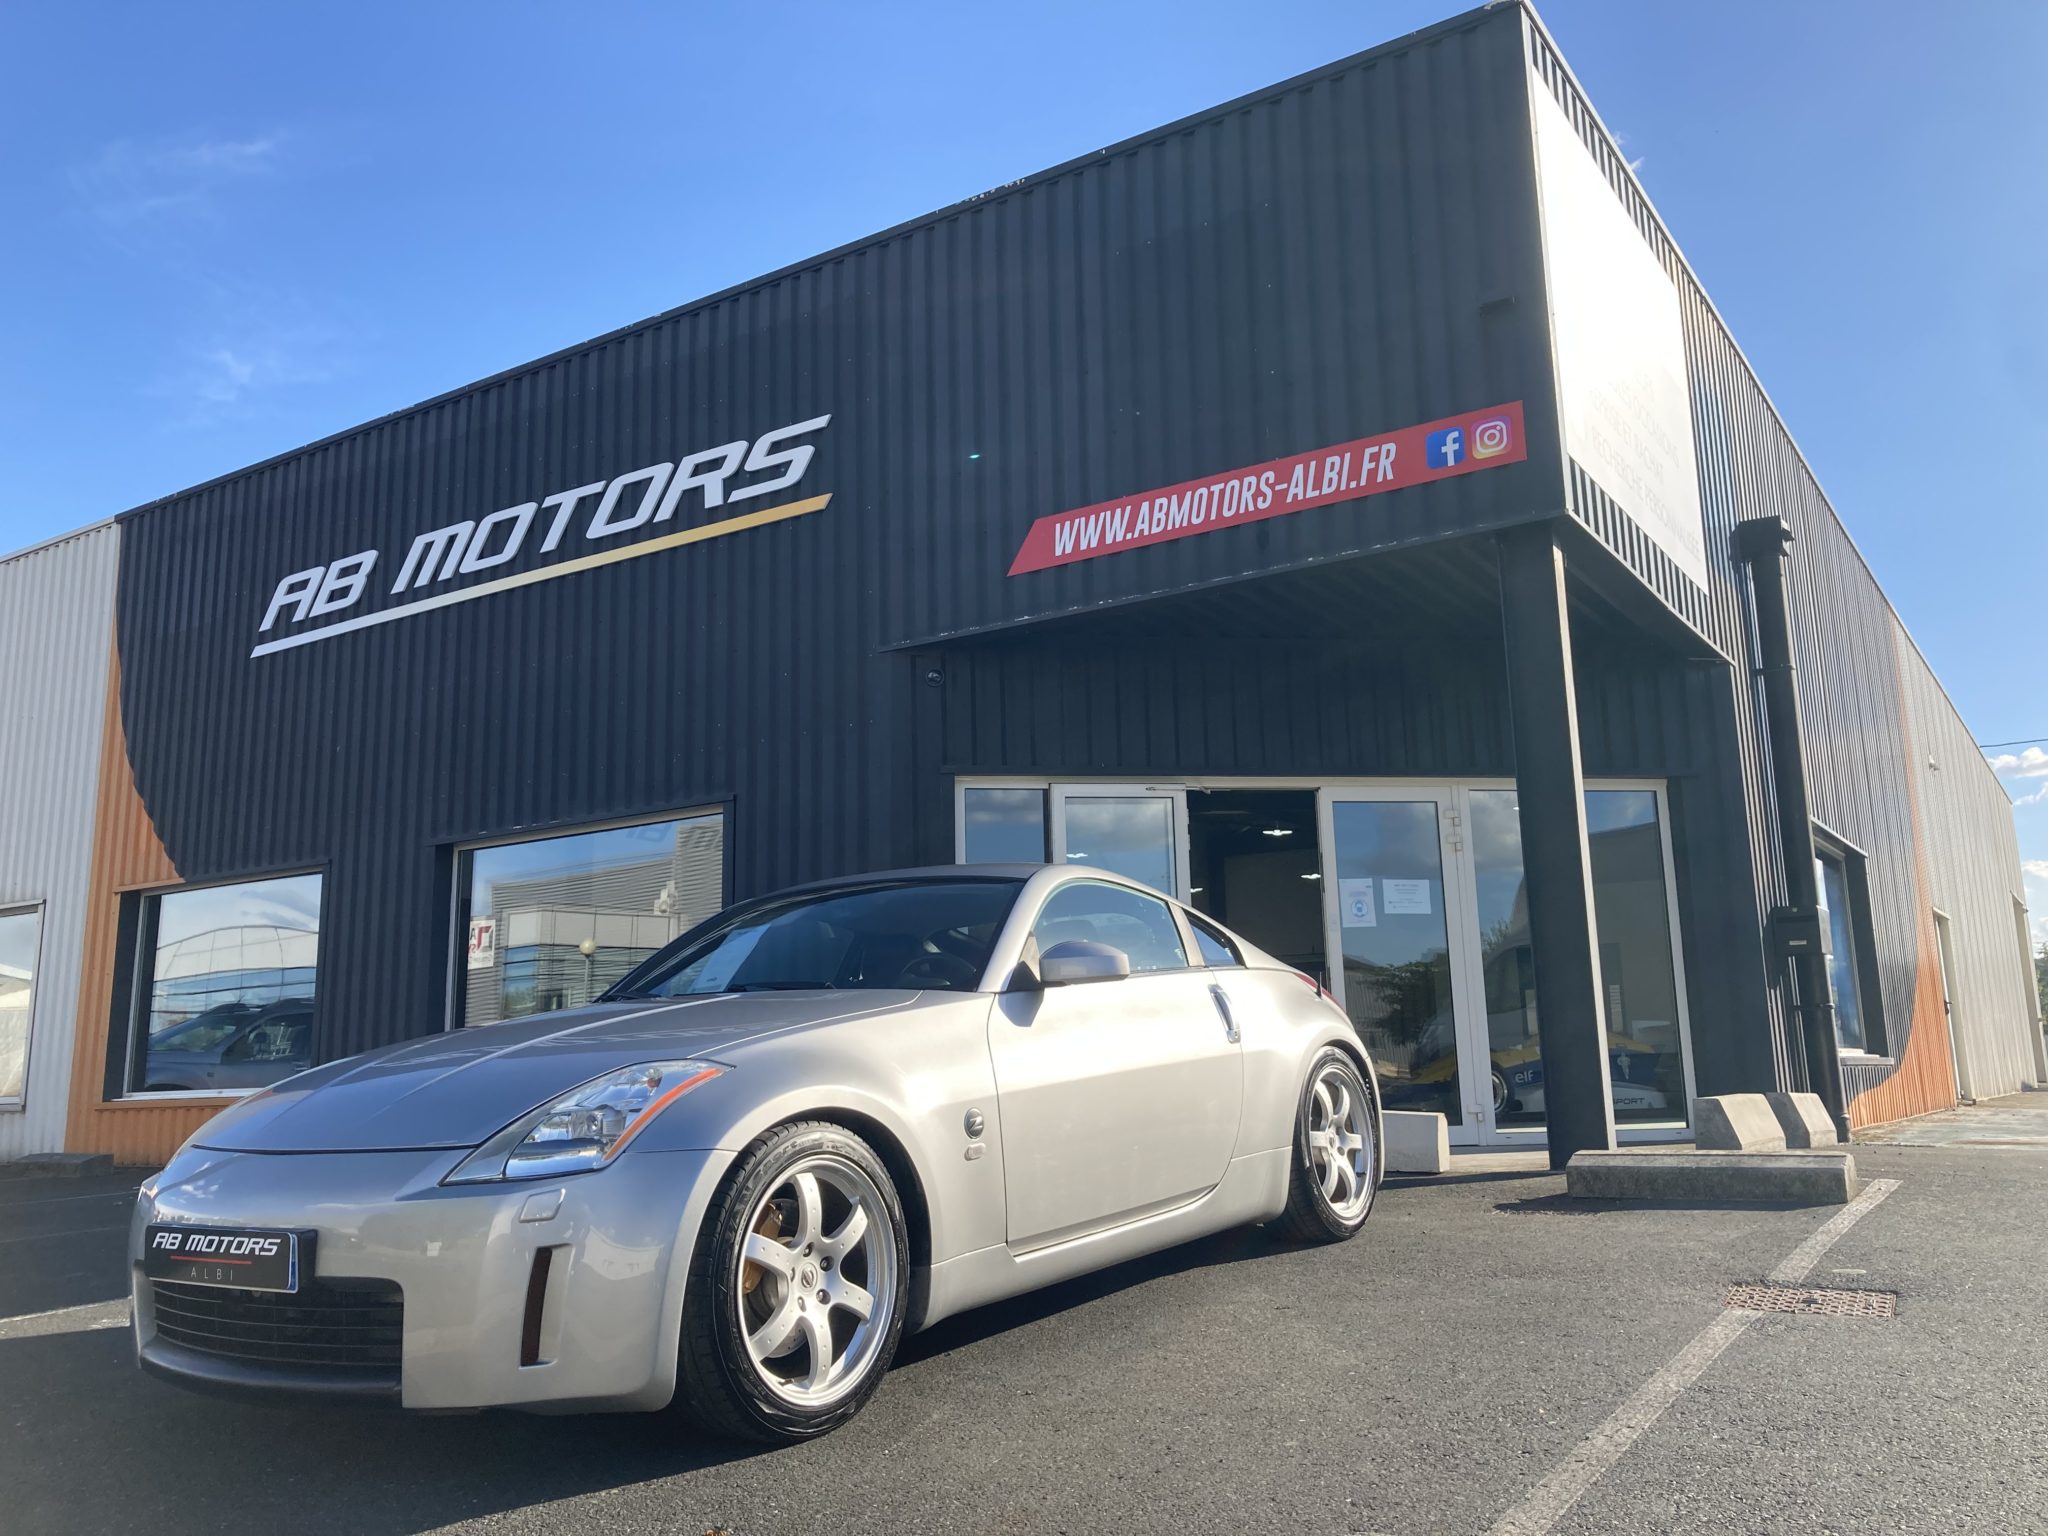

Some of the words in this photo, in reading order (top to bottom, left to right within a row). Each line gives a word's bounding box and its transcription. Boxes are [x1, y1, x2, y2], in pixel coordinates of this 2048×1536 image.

[1053, 442, 1397, 557] WWW.ABMOTORS-ALBI.FR
[258, 549, 378, 632] AB
[390, 413, 832, 595] MOTORS
[1515, 1070, 1535, 1083] elf
[152, 1232, 182, 1249] AB
[185, 1234, 281, 1256] MOTORS
[191, 1267, 233, 1281] ALBI
